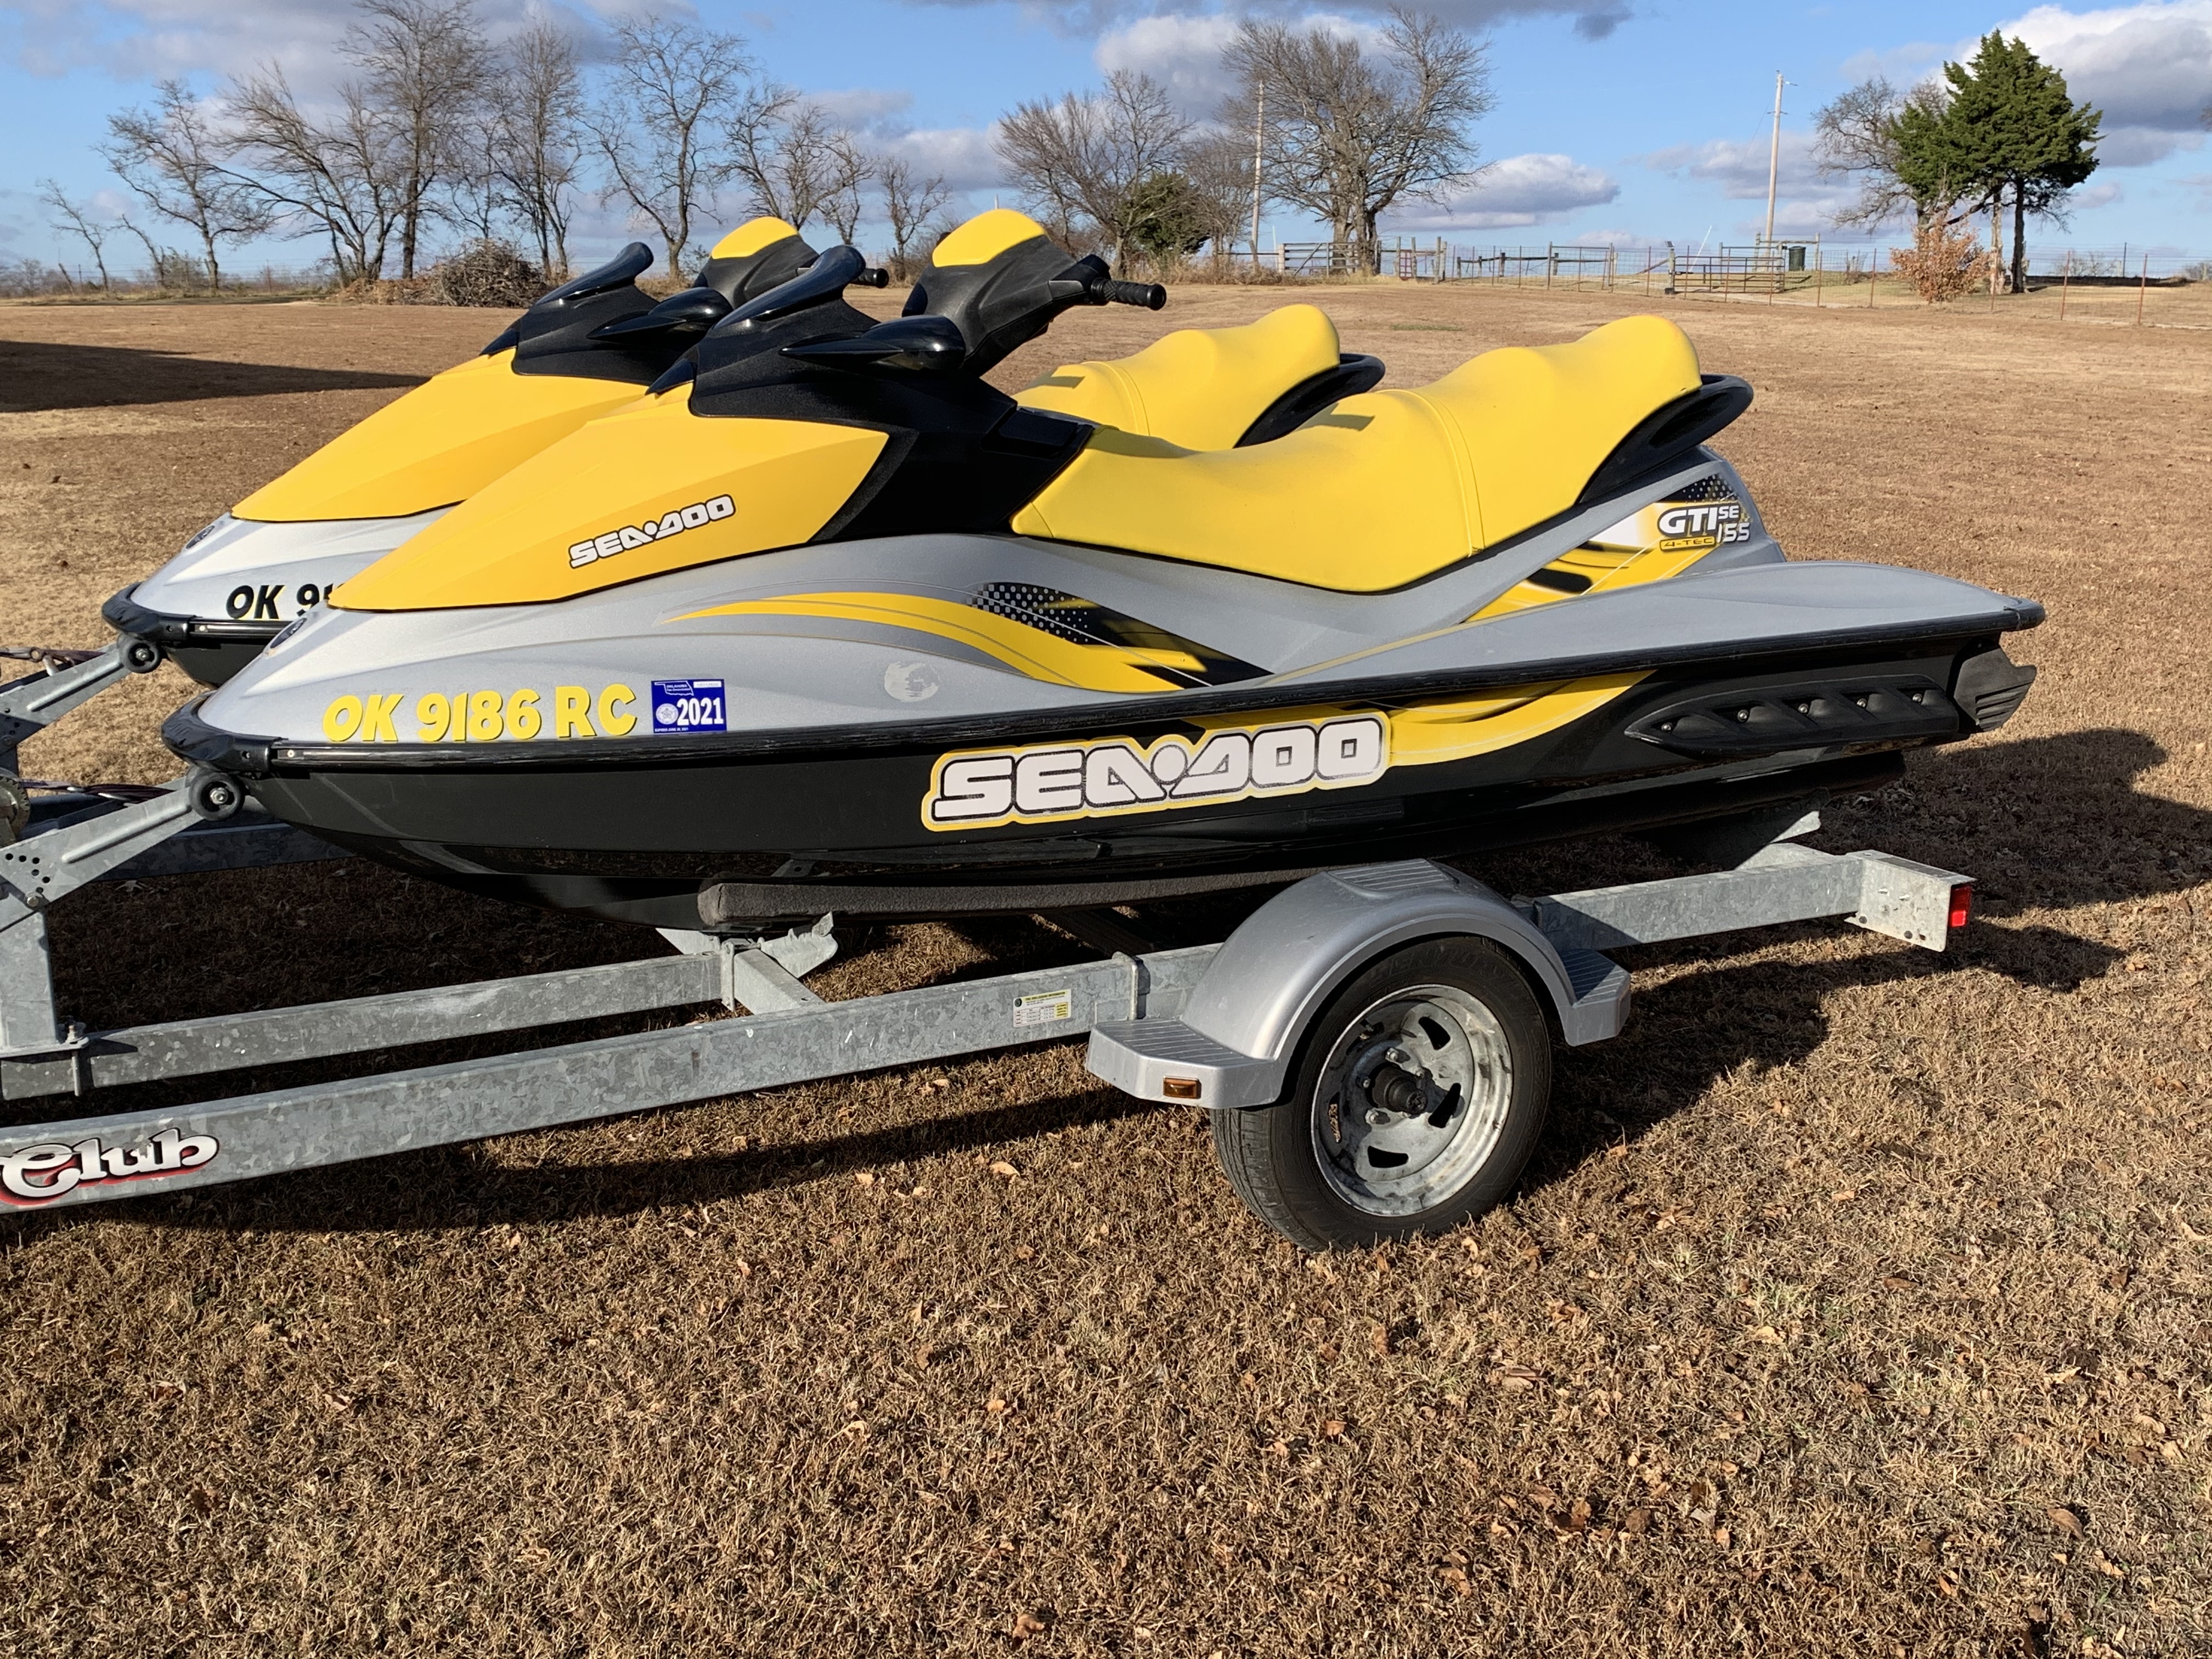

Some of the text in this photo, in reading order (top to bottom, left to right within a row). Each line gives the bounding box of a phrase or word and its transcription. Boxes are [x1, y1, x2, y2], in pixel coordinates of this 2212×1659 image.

[1658, 504, 1740, 535] GTI SE
[1717, 522, 1750, 543] 155
[1663, 537, 1714, 547] 4-TEC
[226, 585, 285, 619] OK
[323, 683, 637, 742] OK 9186 RC
[677, 697, 724, 726] 2021
[0, 1127, 219, 1200] Club
